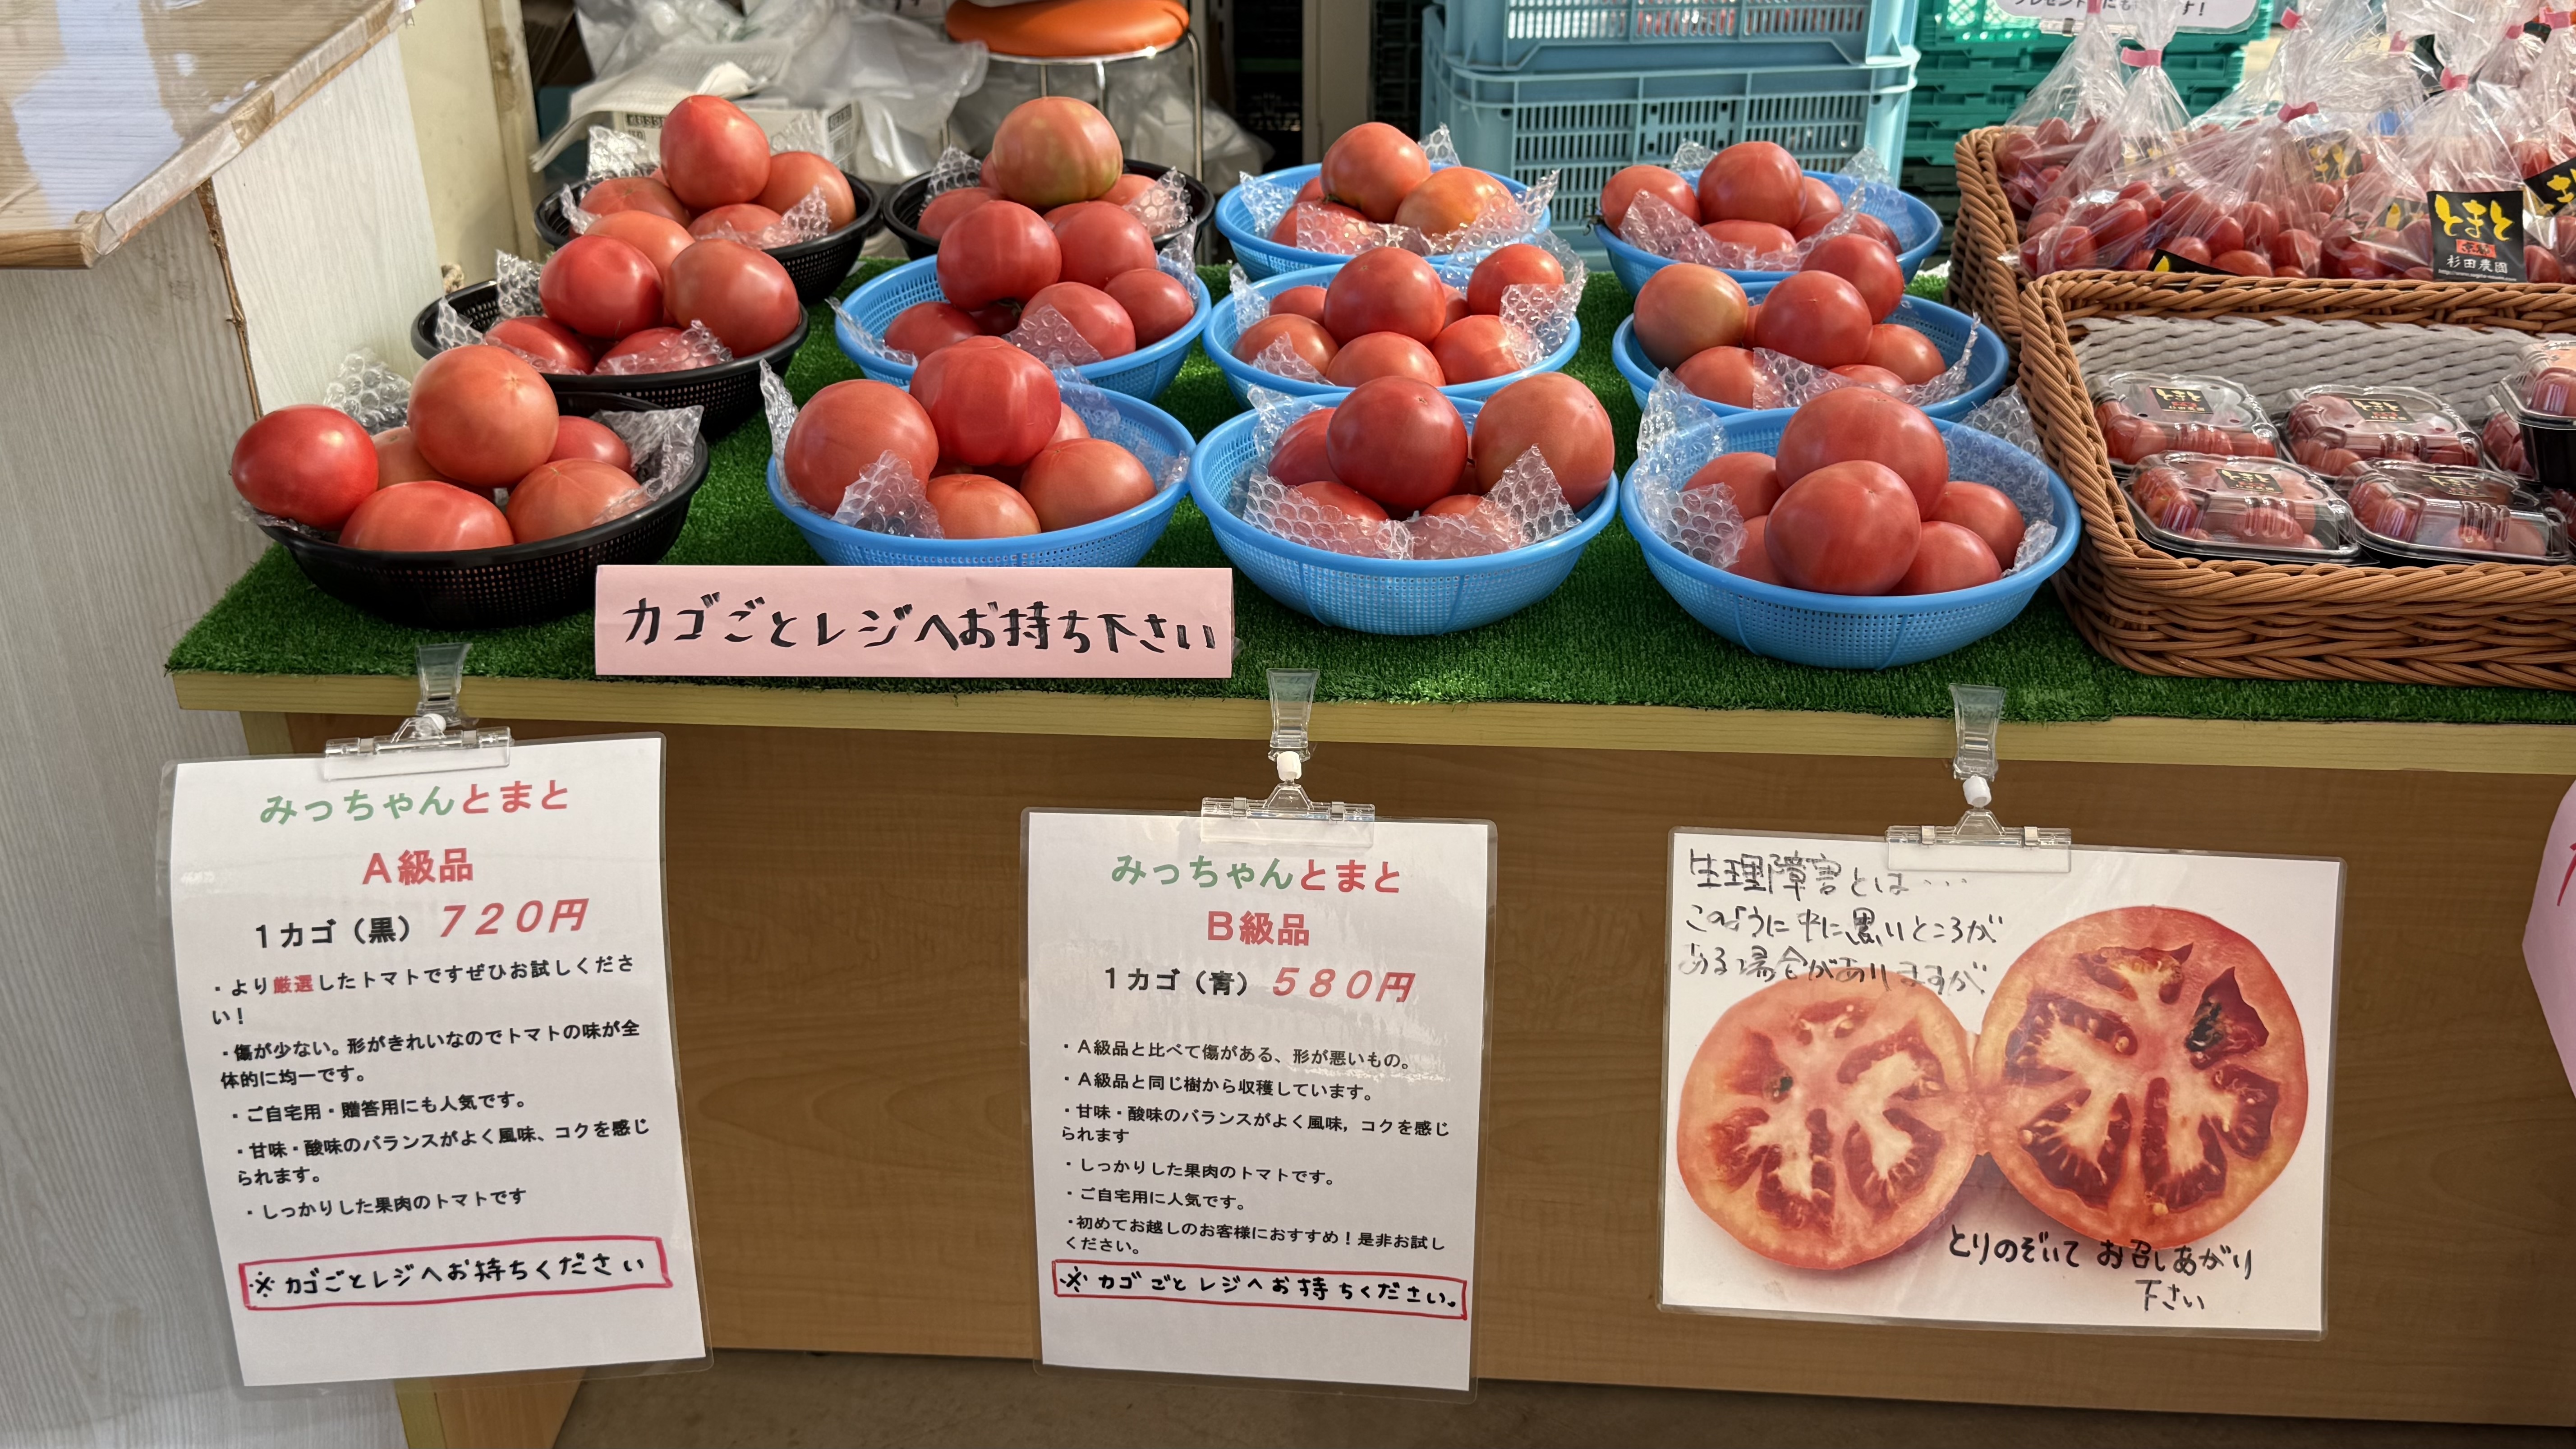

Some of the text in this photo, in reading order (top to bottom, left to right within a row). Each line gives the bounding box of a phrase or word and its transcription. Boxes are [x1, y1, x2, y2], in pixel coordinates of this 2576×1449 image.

[2435, 194, 2514, 241] とまと
[622, 591, 1215, 653] カゴごとレジへお持ち下さい
[260, 780, 569, 825] みっちゃんとまと
[363, 848, 473, 885] A級品
[1111, 855, 1400, 893] みっちゃんとまと
[441, 898, 589, 937] 720円
[1208, 911, 1309, 946] B級品
[1273, 967, 1416, 1003] 580円
[220, 1065, 364, 1090] 体的に均一です。
[1062, 1126, 1129, 1144] られます
[238, 1166, 320, 1186] られます。
[1066, 1236, 1139, 1255] ください。
[2135, 1279, 2204, 1311] 下さい
